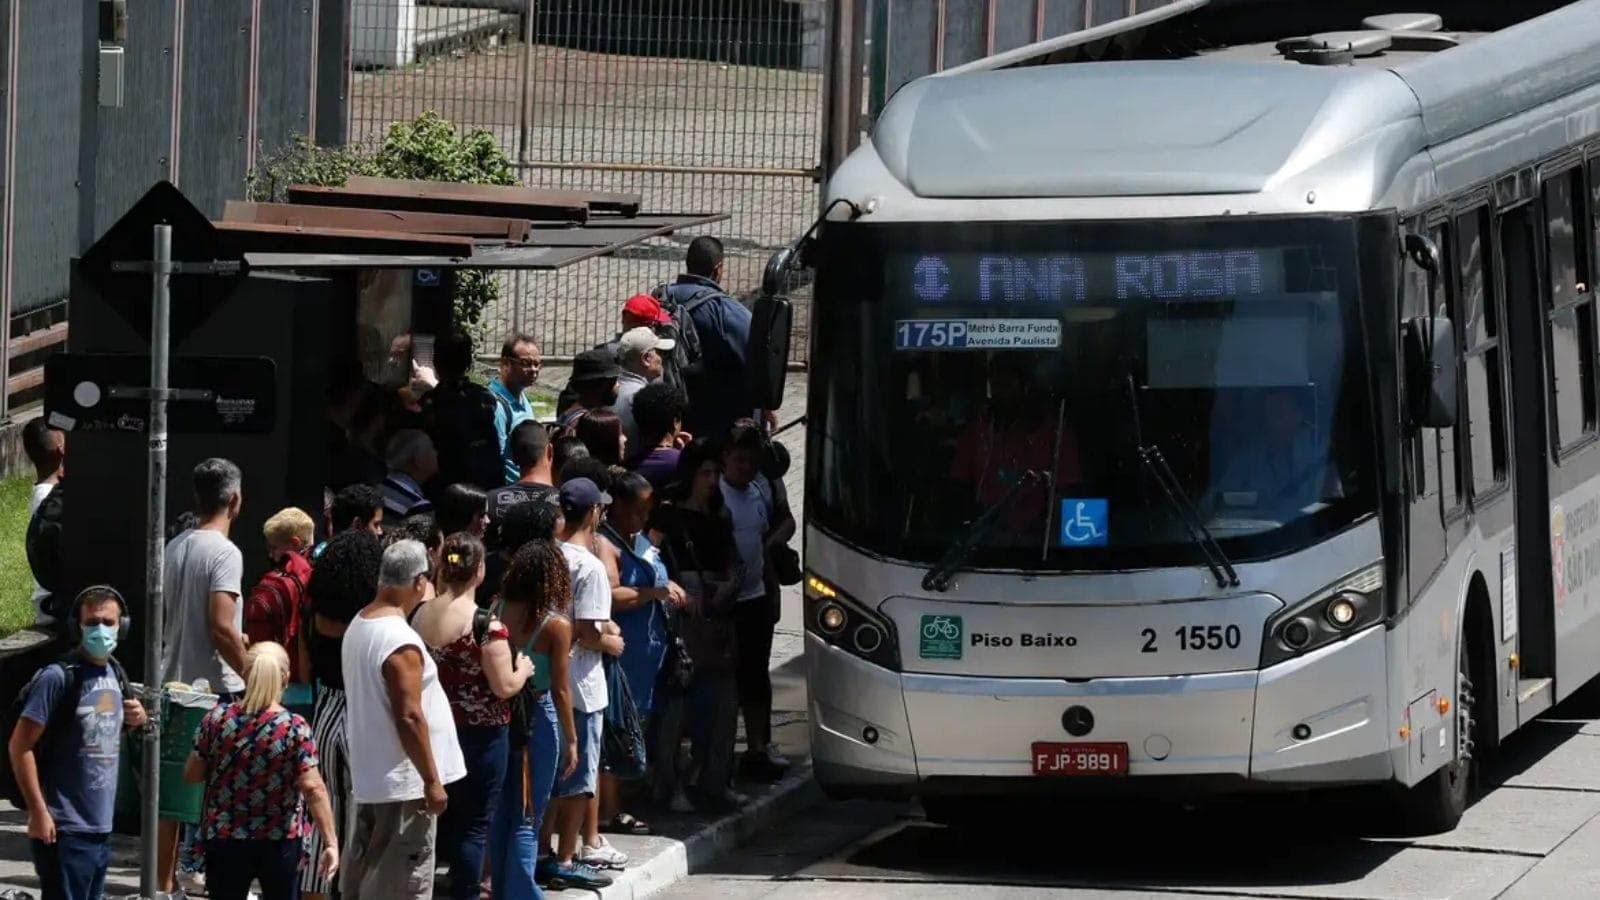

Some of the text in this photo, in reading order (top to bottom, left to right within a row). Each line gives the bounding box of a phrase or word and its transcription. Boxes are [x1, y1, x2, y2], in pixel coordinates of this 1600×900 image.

[979, 250, 1262, 301] ANA ROSA
[898, 322, 966, 347] 175P
[998, 323, 1026, 333] Barra
[1027, 323, 1059, 333] Funda
[968, 336, 1057, 345] Avenida Paulista
[970, 632, 1077, 648] Piso Baixo
[1141, 624, 1241, 653] 2 1550
